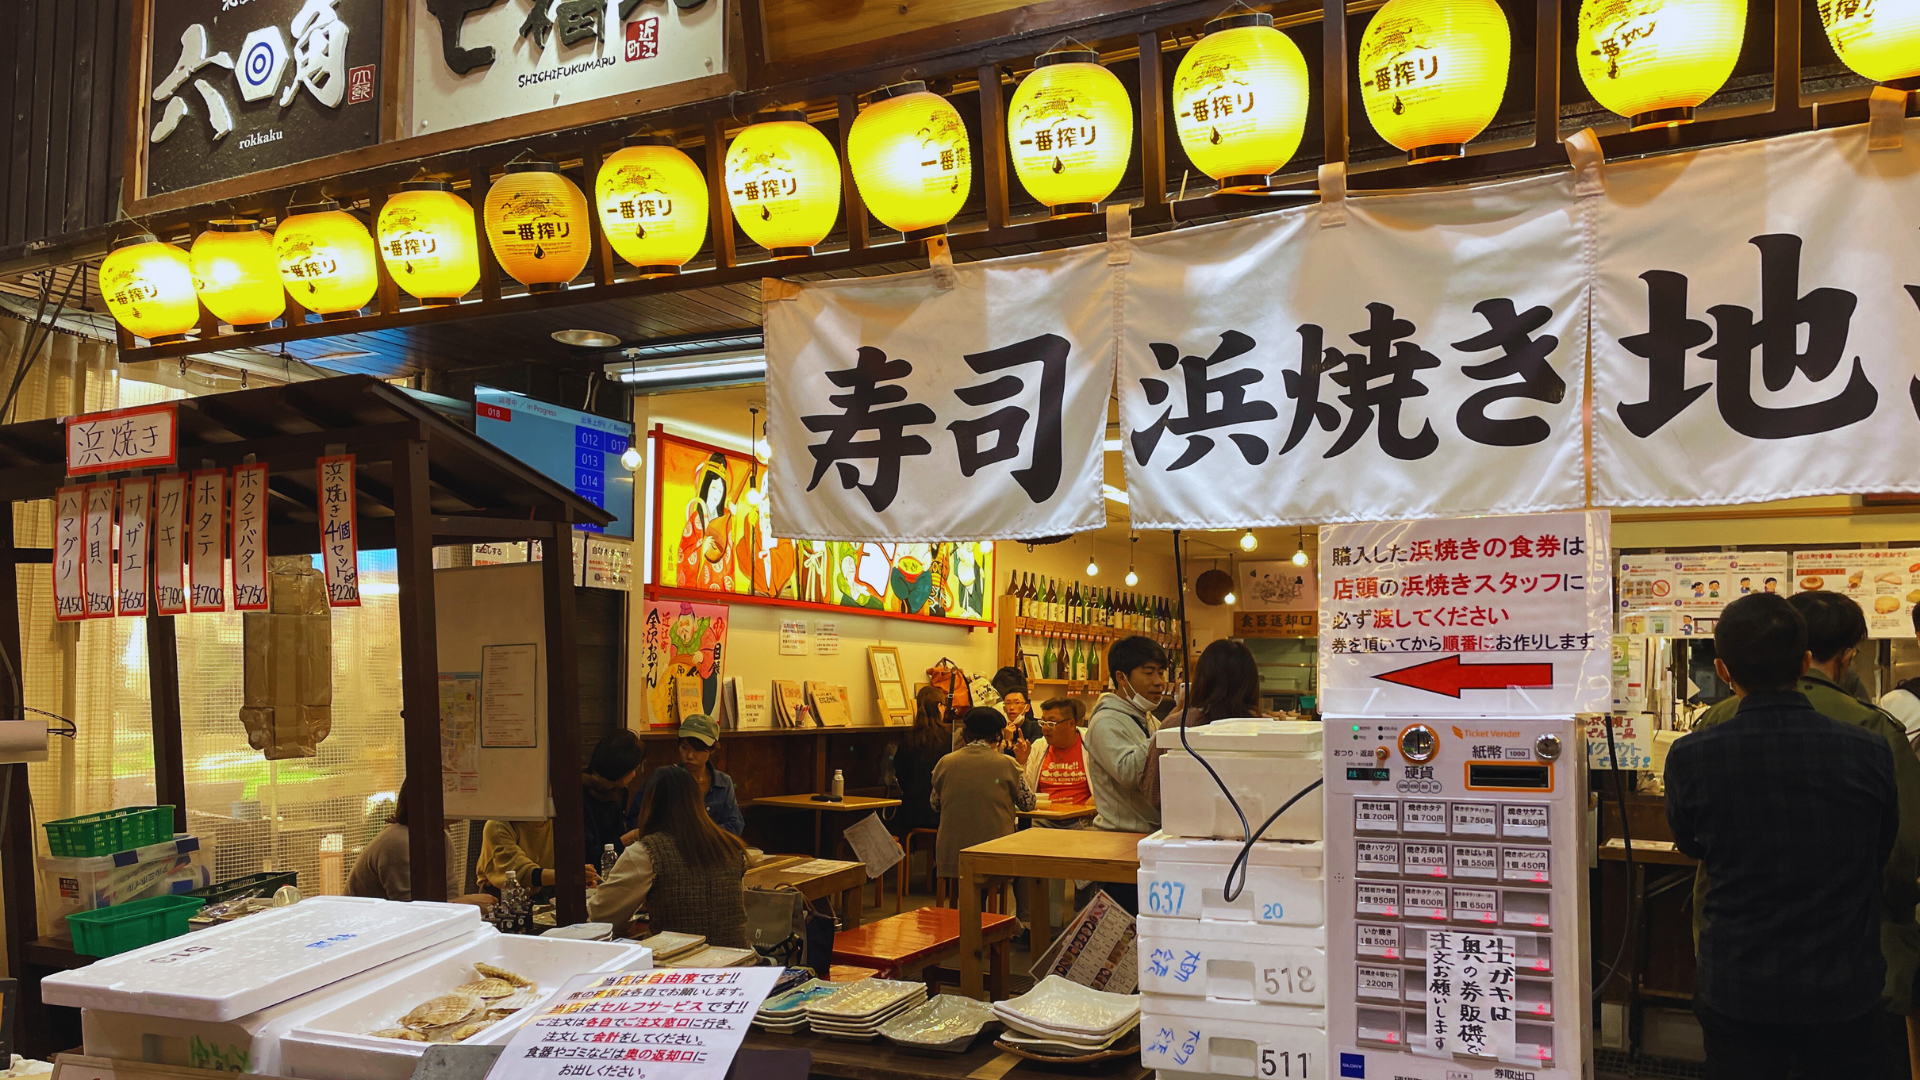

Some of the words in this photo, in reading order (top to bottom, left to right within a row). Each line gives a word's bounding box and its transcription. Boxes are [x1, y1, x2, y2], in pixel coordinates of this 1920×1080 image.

[518, 55, 617, 88] SHICHIFUKUMARU
[1364, 54, 1438, 91] 一番搾り
[1180, 92, 1254, 122] 一番搾り
[239, 128, 284, 150] rokkaku
[1019, 126, 1096, 151] 一番搾り
[733, 177, 797, 201] 一番搾り
[607, 199, 672, 218] 一番搾り
[502, 222, 570, 240] 一番搾り
[384, 237, 436, 257] 一番搾り
[282, 257, 337, 278] 一番搾り
[109, 285, 158, 305] 一番搾り
[1617, 234, 1920, 441] 地
[1131, 299, 1563, 470] 浜焼き
[488, 408, 500, 418] 018
[533, 405, 557, 417] Progress
[614, 424, 629, 434] Ready
[800, 334, 1071, 512] 寿司
[78, 419, 159, 464] 浜焼き
[582, 432, 598, 446] 012
[611, 439, 627, 452] 017
[582, 453, 598, 467] 013
[582, 474, 598, 487] 014
[90, 488, 112, 564] バイ貝
[161, 491, 179, 547] カキ
[198, 481, 216, 556] ホタテ
[239, 470, 258, 574] ホタテバター
[324, 459, 352, 577] 浜焼き4個セット
[61, 497, 80, 580] ハマグリ
[124, 494, 144, 571] サザエ
[1332, 534, 1585, 566] 購入した浜焼きの食券は
[236, 584, 267, 605] ¥750
[327, 582, 358, 602] ¥2200
[1332, 571, 1585, 600] 店頭の浜焼きスタッフに
[87, 595, 113, 612] ¥550
[120, 591, 145, 609] ¥650
[158, 586, 184, 605] ¥700
[192, 586, 223, 605] ¥700
[57, 596, 84, 614] ¥450
[1241, 614, 1312, 628] 食器返却口
[1332, 605, 1510, 630] 必ず渡してください
[1331, 633, 1596, 654] 券を頂いてから順番にお作りします
[1464, 729, 1489, 738] Ticket
[1491, 730, 1521, 738] Vender
[1334, 749, 1375, 758] おつり・返却
[1472, 745, 1502, 760] 紙幣
[1597, 755, 1650, 769] でます!
[1404, 765, 1434, 780] 硬貨
[1408, 804, 1442, 812] 焼きホタテ
[1507, 808, 1544, 816] 焼きサザエ
[1421, 814, 1444, 822] 700円
[1373, 854, 1396, 862] 450円
[1421, 856, 1444, 864] 450円
[1149, 881, 1185, 915] 637
[1373, 896, 1396, 904] 950円
[1420, 899, 1444, 907] 600円
[1470, 902, 1494, 910] 650円
[1263, 903, 1283, 919] 20
[1364, 926, 1392, 936] いか焼き
[1374, 938, 1396, 946] 500円
[602, 972, 741, 986] 当店は自由席です!!
[1263, 965, 1316, 995] 518
[1366, 980, 1394, 988] 2200円
[1429, 932, 1454, 1049] 注文お願いします
[550, 1001, 750, 1014] 当店はセルフサービスです!!
[535, 1017, 732, 1030] ご注文は各自でご注文窓口に行き、
[541, 1031, 703, 1046] 注文して会計をしてください。
[524, 1046, 709, 1063] 食器やゴミなどは奥の返却口に
[558, 1063, 646, 1080] お出しください。
[1261, 1049, 1307, 1079] 511
